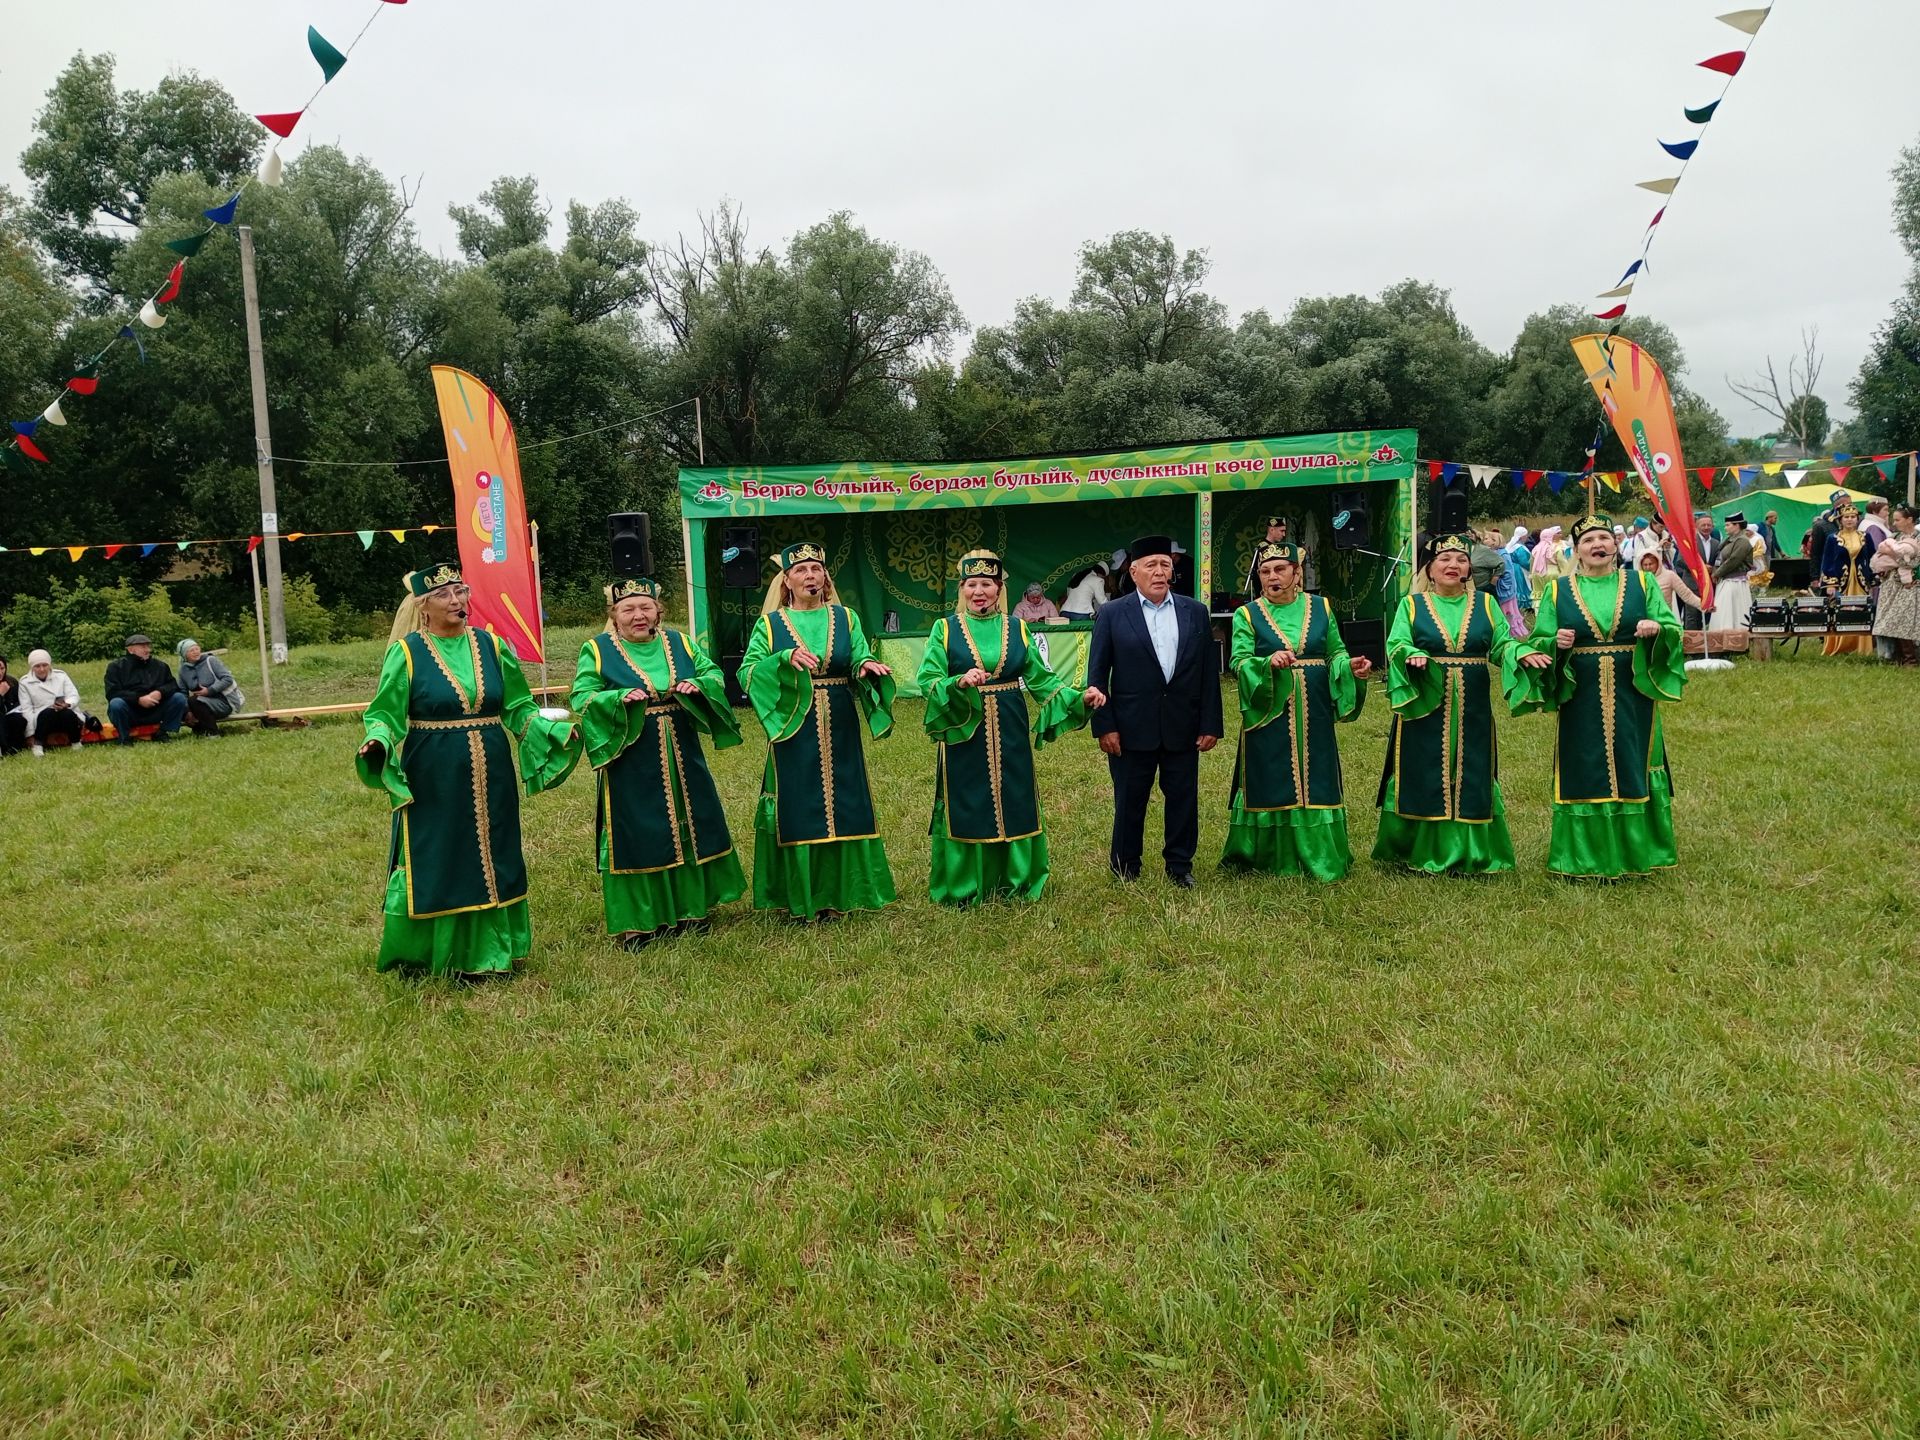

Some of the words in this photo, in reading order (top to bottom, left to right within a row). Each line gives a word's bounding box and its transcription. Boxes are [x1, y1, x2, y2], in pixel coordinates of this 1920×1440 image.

[742, 481, 807, 501] Бергә
[813, 476, 902, 499] булыйк,
[909, 473, 987, 494] бердәм
[994, 466, 1081, 490] булыйк,
[1087, 462, 1208, 485] дуслыкның
[1215, 460, 1264, 473] көче
[1272, 454, 1358, 474] шунда...
[480, 502, 492, 524] ЛЕТО
[492, 483, 503, 543] ТАТАРСТАНЕ
